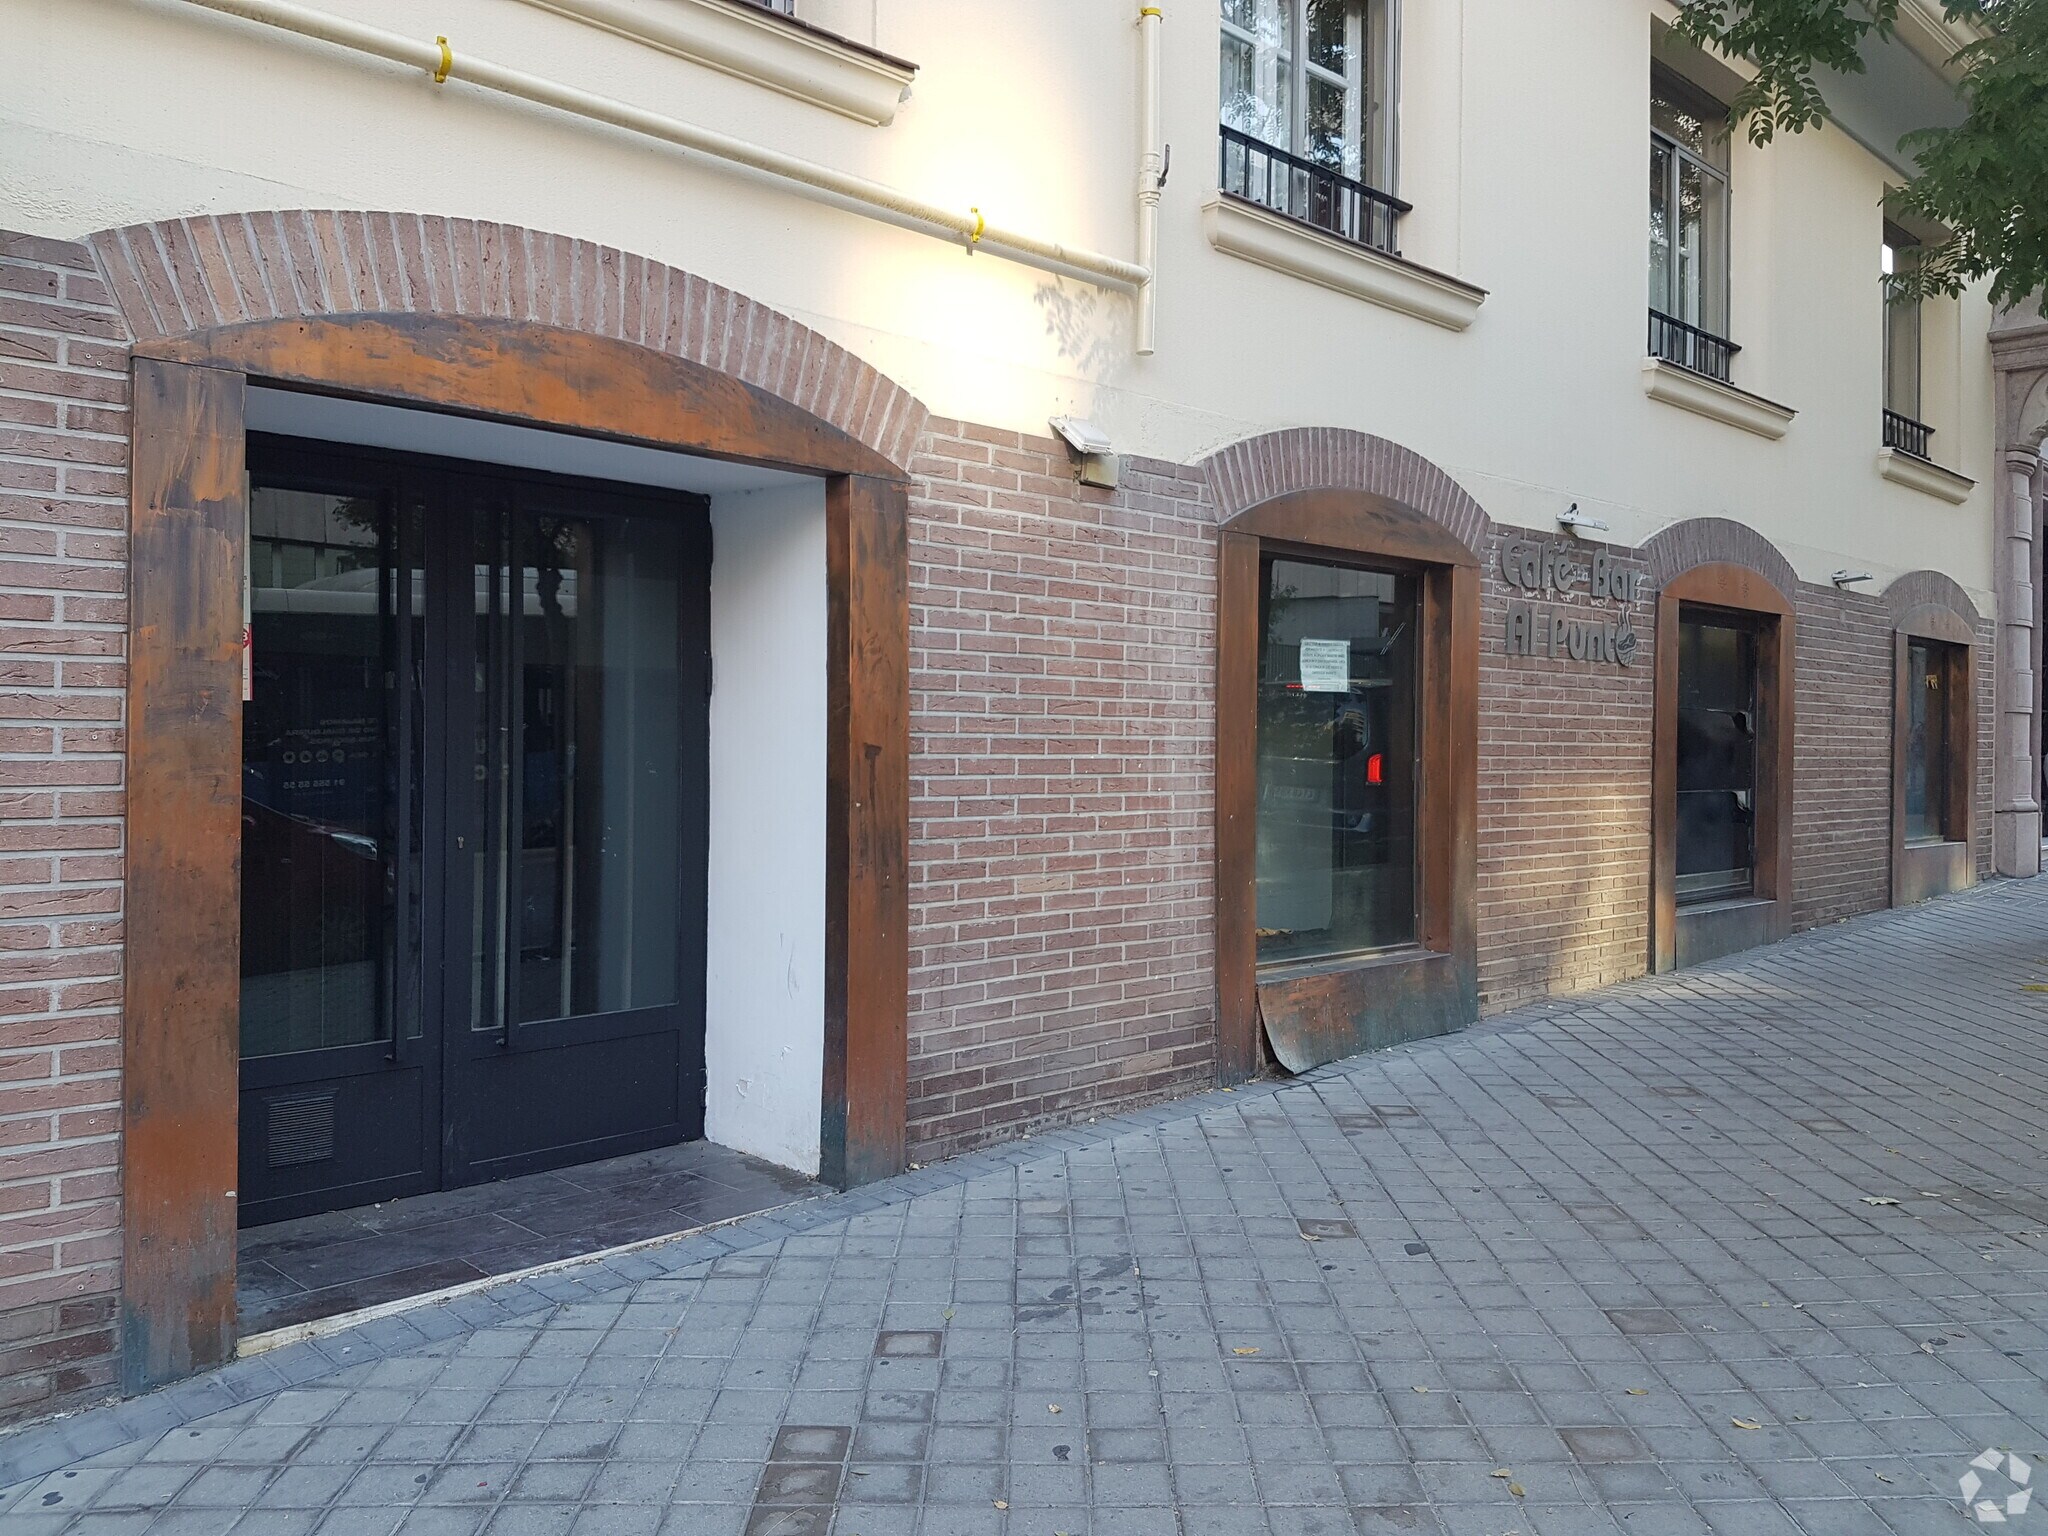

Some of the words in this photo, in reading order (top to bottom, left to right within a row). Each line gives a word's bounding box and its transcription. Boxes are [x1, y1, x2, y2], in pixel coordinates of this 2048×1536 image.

[1502, 533, 1574, 592] Café
[1591, 548, 1640, 601] Bar
[1505, 602, 1537, 656] Al
